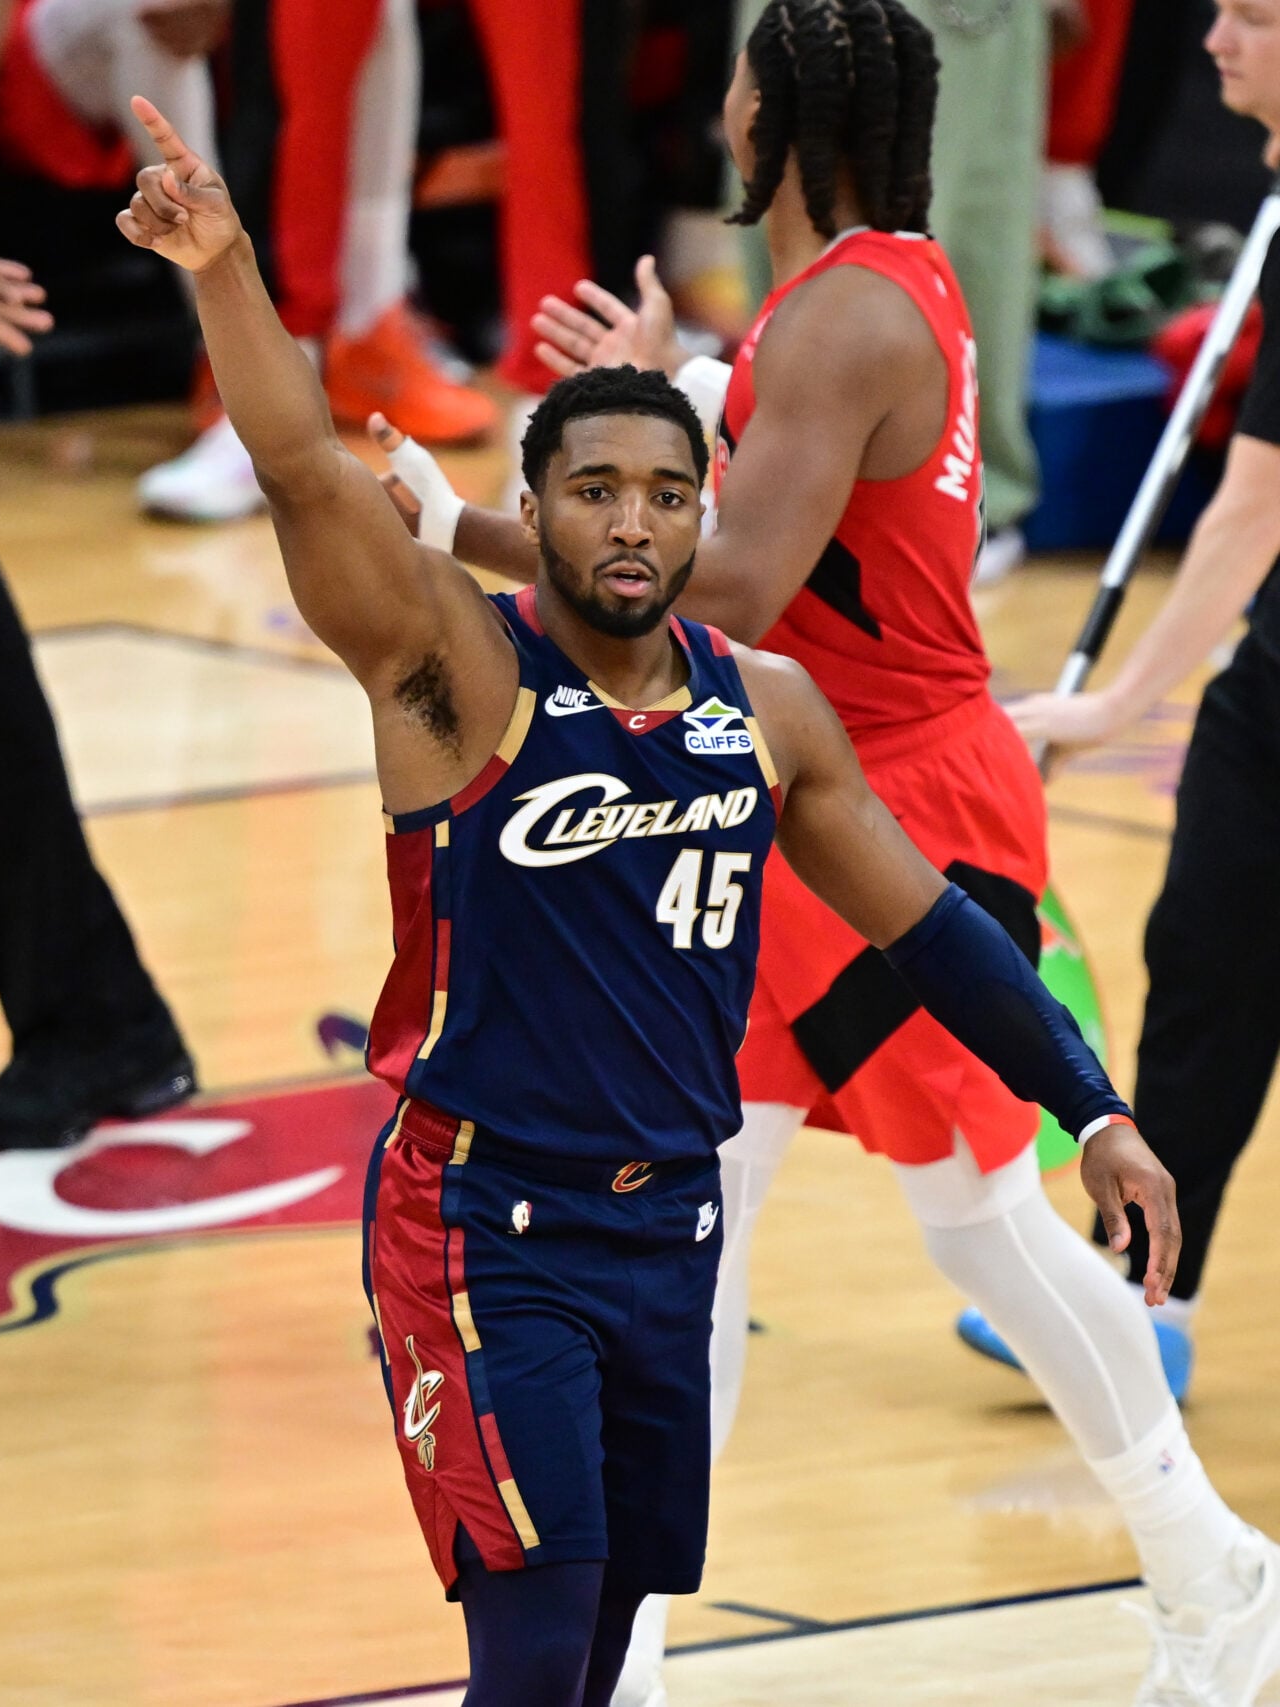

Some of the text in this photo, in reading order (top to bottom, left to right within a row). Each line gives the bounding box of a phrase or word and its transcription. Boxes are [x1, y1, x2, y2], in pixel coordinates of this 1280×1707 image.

[554, 684, 592, 708] NIKE
[628, 714, 648, 730] C
[688, 734, 752, 751] CLIFFS
[498, 772, 759, 868] CLEVELAND
[656, 848, 753, 950] 45
[611, 1160, 654, 1194] C
